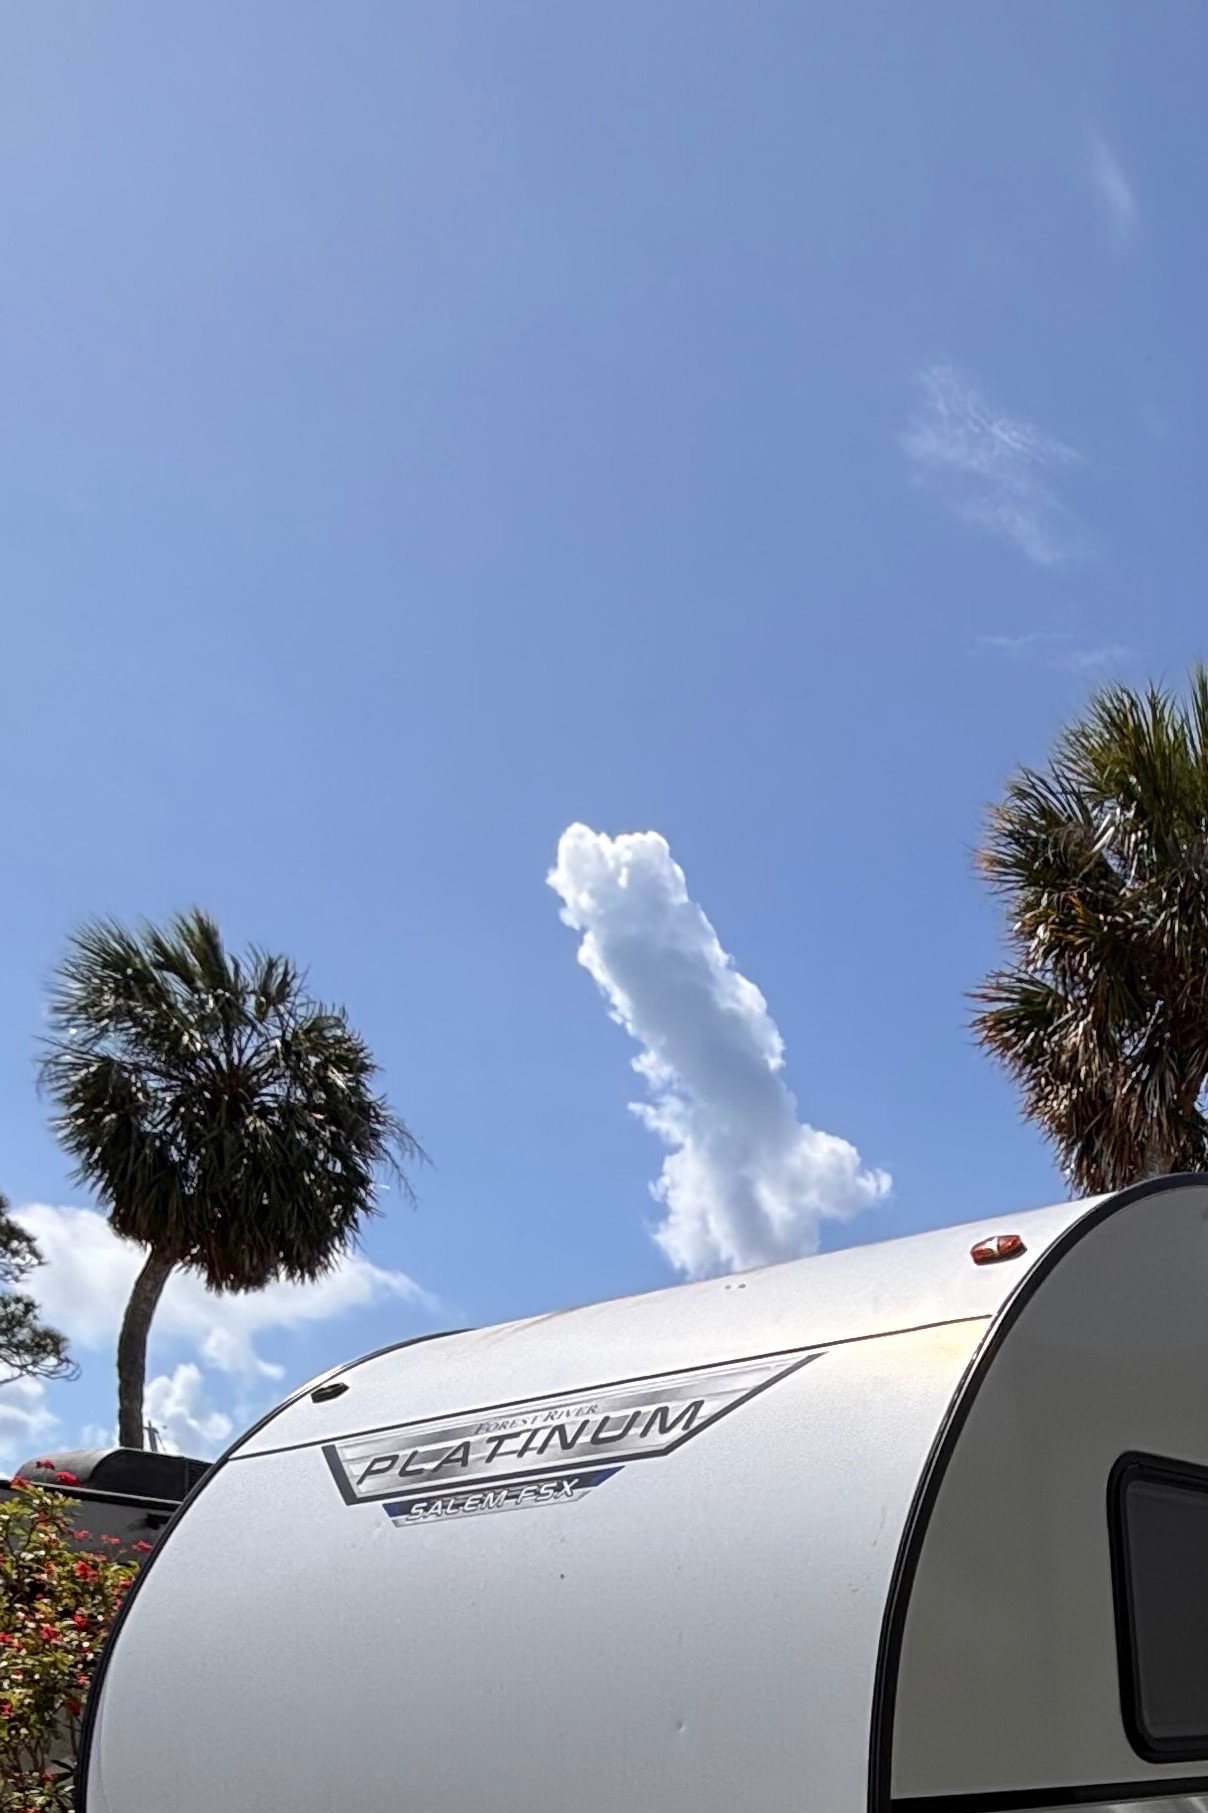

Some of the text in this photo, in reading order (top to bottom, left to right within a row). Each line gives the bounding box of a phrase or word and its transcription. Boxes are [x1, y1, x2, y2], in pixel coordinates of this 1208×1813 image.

[475, 1404, 599, 1435] FOREST RIVER
[356, 1400, 705, 1486] PLATINUM
[406, 1477, 580, 1521] SALEM FSX
